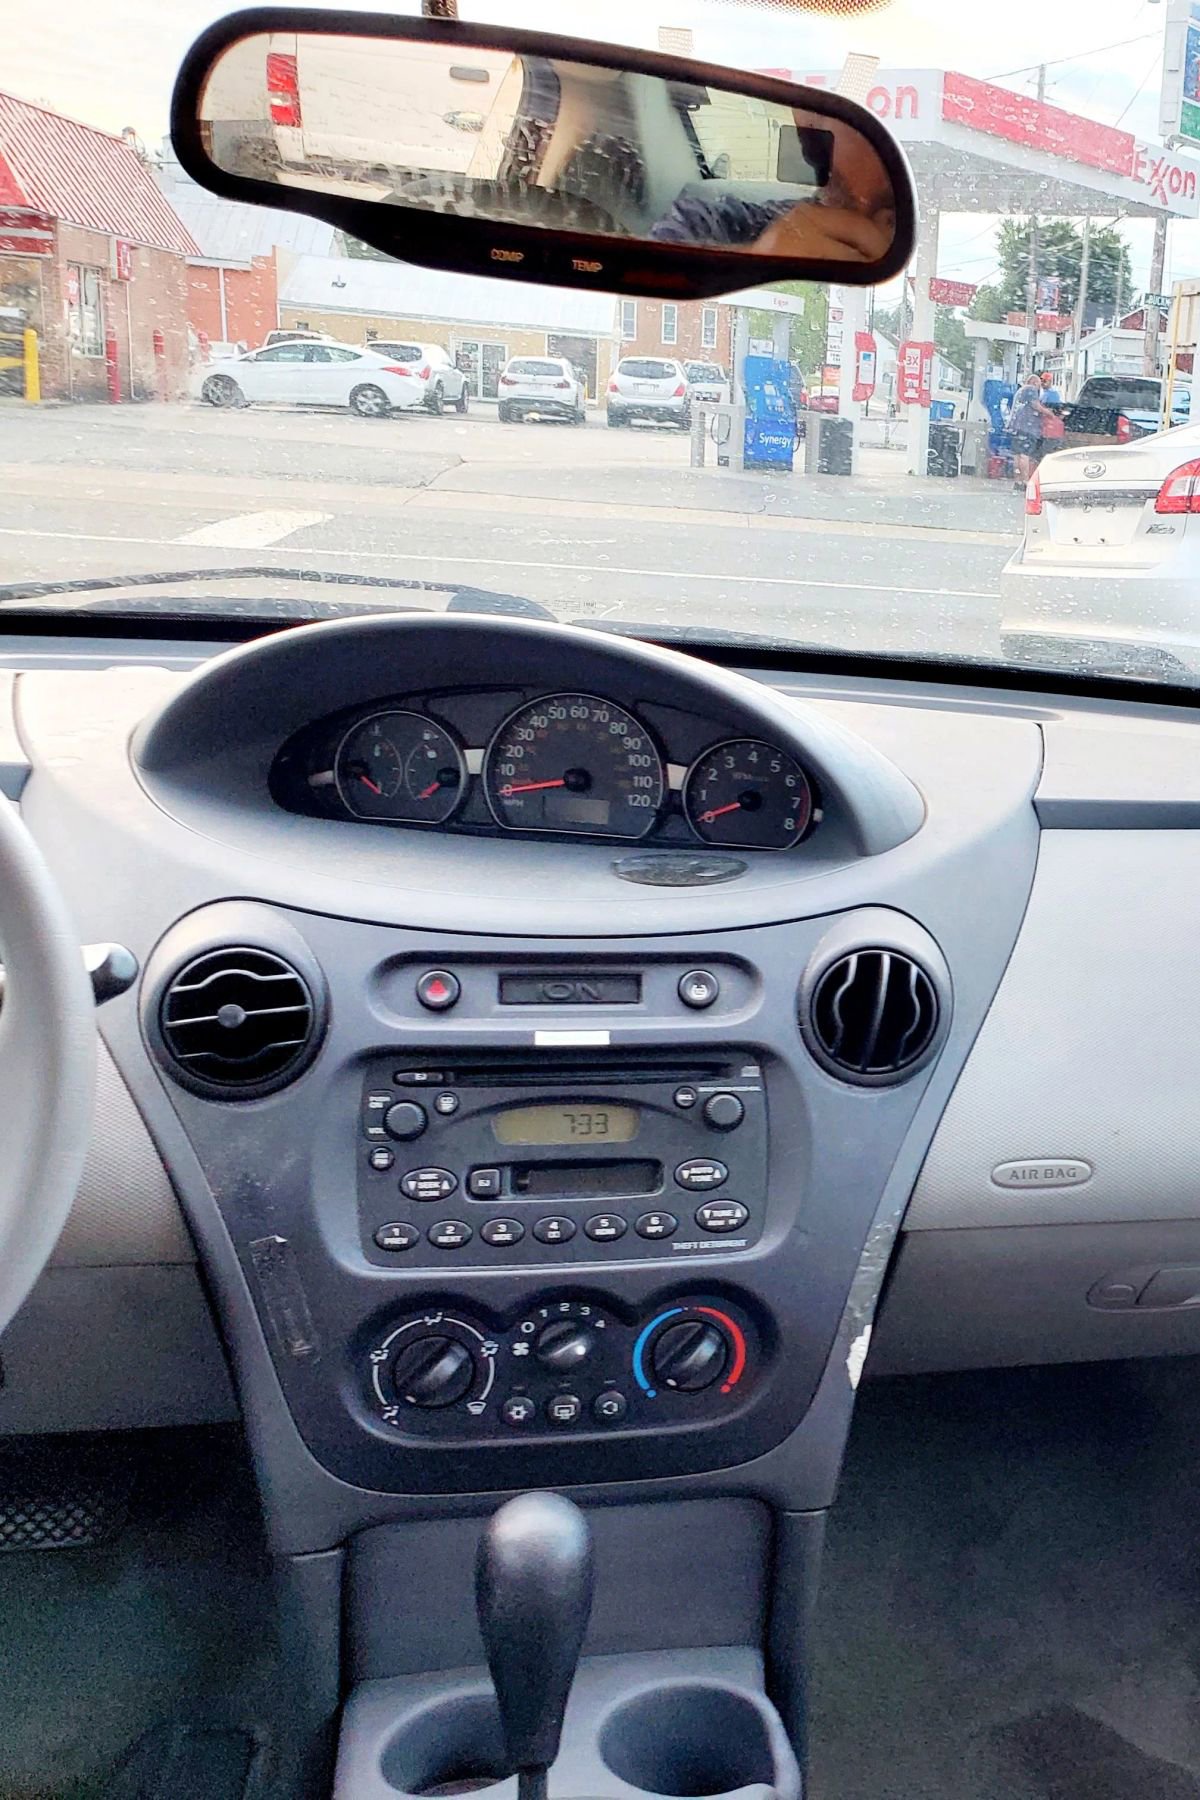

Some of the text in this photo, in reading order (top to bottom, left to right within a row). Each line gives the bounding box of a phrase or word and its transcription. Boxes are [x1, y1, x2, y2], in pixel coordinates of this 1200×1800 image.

[1133, 146, 1196, 206] Exxon
[572, 259, 603, 273] TEMP
[905, 355, 919, 366] 3X
[759, 432, 792, 448] Synergy
[548, 706, 566, 719] 50
[570, 706, 588, 718] 60
[591, 710, 609, 722] 70
[529, 715, 548, 728] 40
[517, 728, 534, 741] 30
[609, 722, 627, 735] 80
[622, 737, 641, 750] 90
[505, 745, 524, 758] 20
[748, 751, 758, 763] 4
[628, 754, 650, 767] 100
[725, 756, 735, 768] 3
[770, 760, 781, 773] 5
[501, 763, 515, 776] 10
[708, 768, 718, 781] 2
[633, 775, 653, 788] 110
[785, 774, 796, 787] 6
[628, 794, 650, 807] 120
[700, 789, 707, 801] 1
[791, 797, 801, 809] 7
[784, 818, 795, 830] 8
[562, 1113, 609, 1135] 7:33
[1009, 1167, 1077, 1180] AIR BAG
[417, 1181, 441, 1189] SEEK
[549, 1222, 559, 1230] 4
[600, 1219, 609, 1227] 5
[650, 1217, 660, 1225] 6
[392, 1228, 400, 1236] 1
[445, 1226, 456, 1234] 2
[497, 1224, 507, 1233] 3
[672, 1241, 698, 1250] THEFT
[540, 1309, 548, 1318] 1
[560, 1303, 570, 1312] 2
[580, 1306, 591, 1316] 3
[594, 1320, 605, 1328] 4
